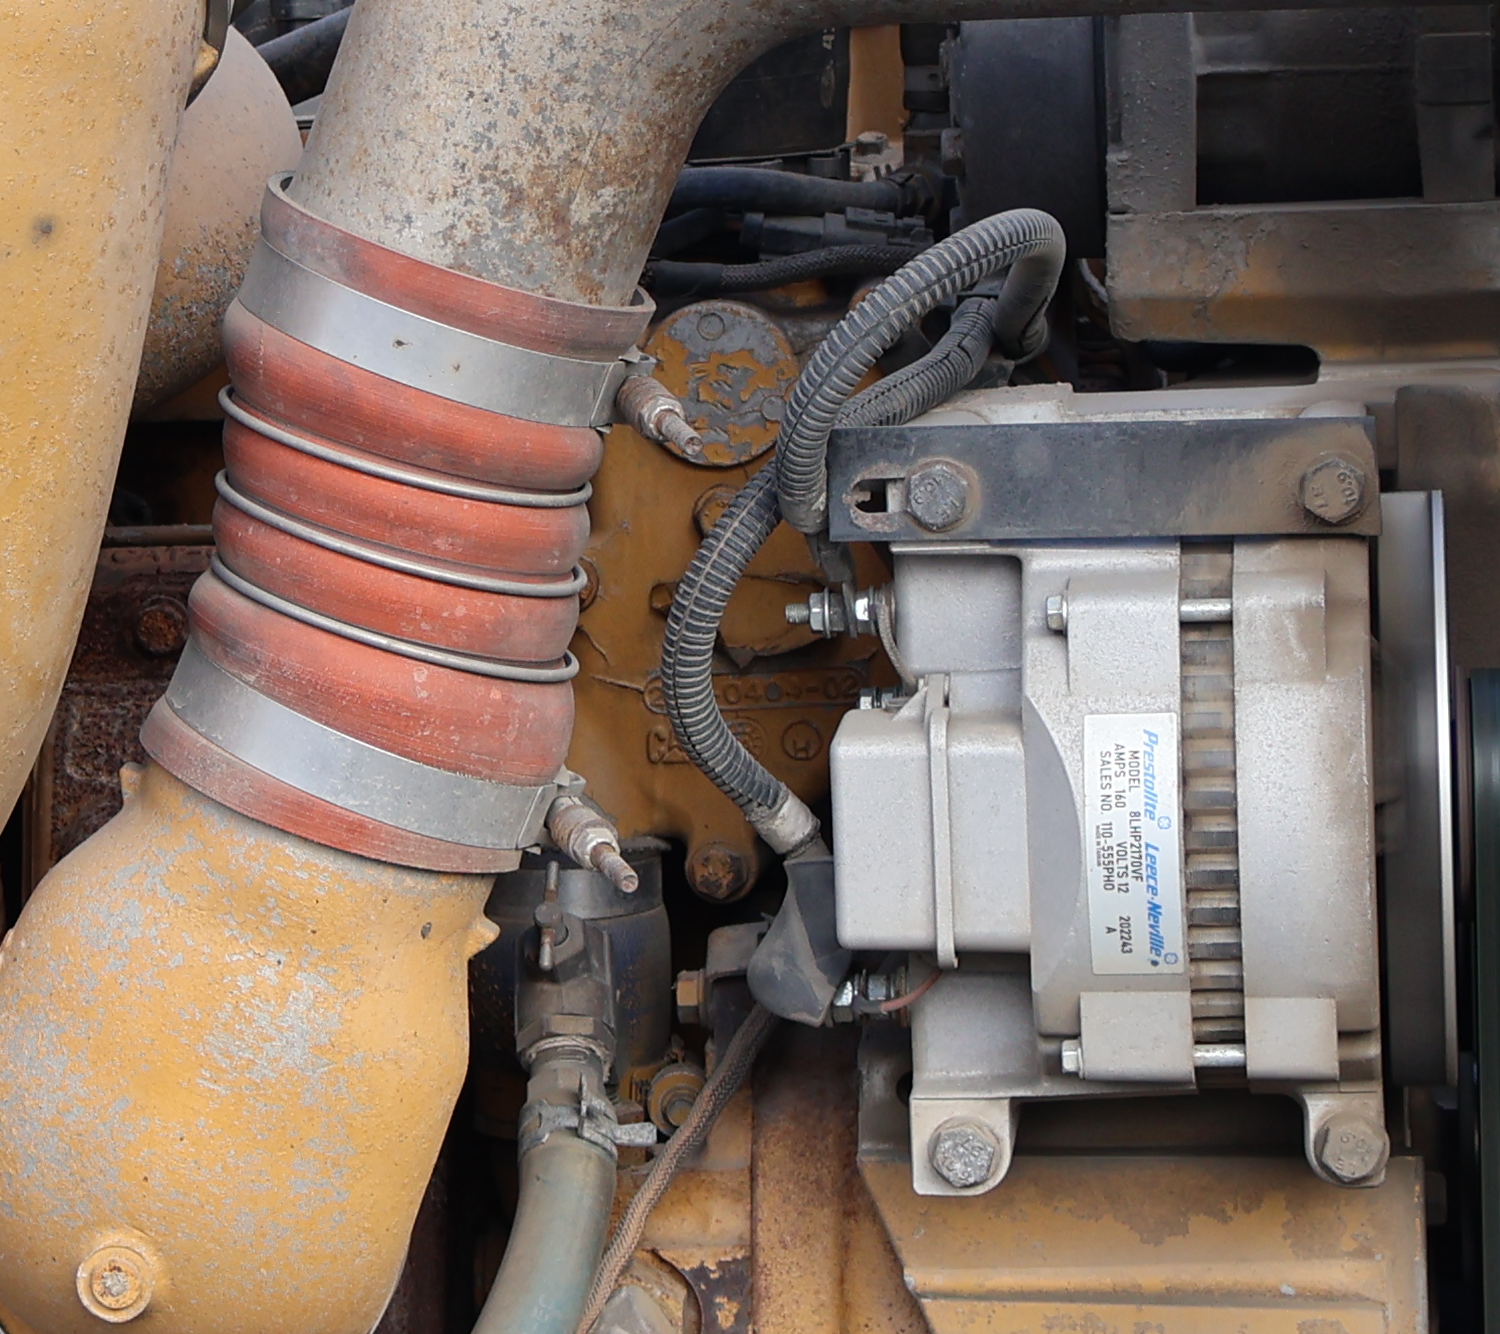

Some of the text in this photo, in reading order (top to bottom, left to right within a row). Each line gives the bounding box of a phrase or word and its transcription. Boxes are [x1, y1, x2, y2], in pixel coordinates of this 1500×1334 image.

[1100, 750, 1112, 791] SALES
[1143, 729, 1159, 822] Prestolite
[1100, 795, 1112, 815] NO.
[1128, 750, 1143, 883] MODEL 8LHP2170VF
[1114, 743, 1132, 954] AMPS 160 VOLTS 12 202243
[1105, 926, 1117, 934] A
